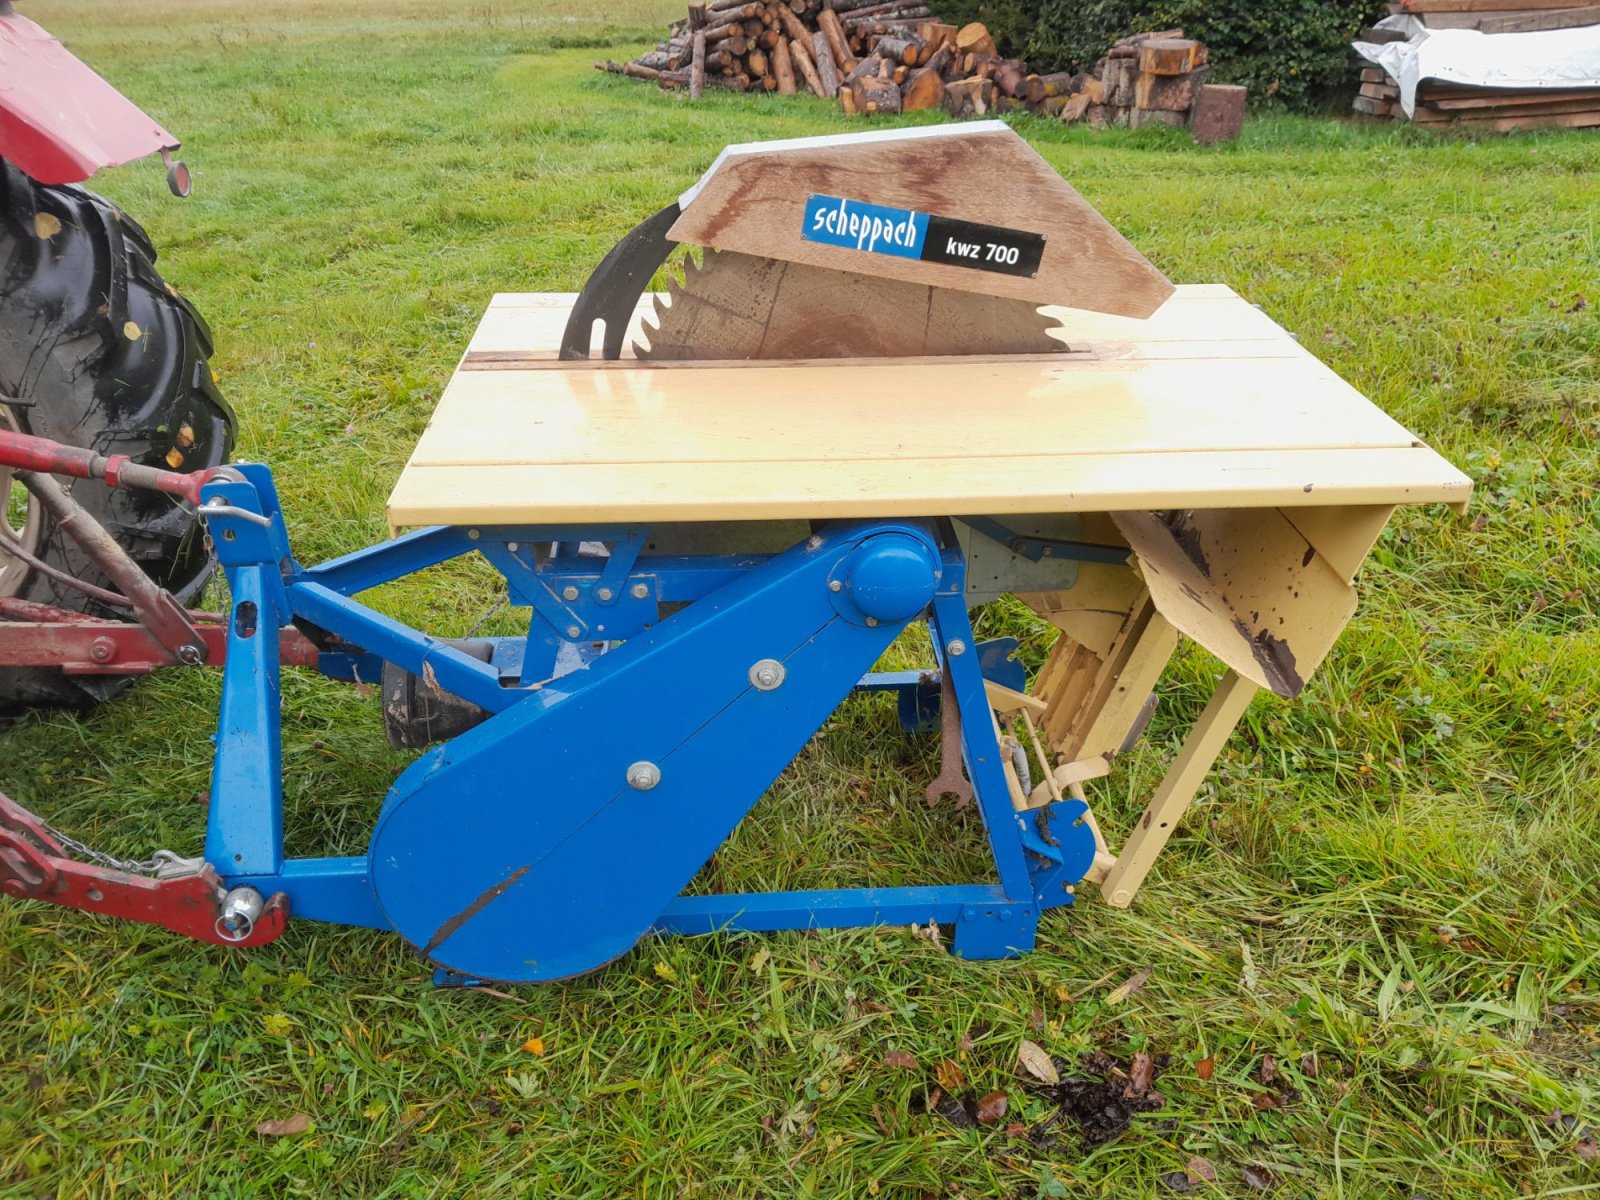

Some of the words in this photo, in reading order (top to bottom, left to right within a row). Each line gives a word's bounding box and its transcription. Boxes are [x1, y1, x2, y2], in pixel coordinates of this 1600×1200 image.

[813, 198, 917, 252] scheppach
[946, 237, 980, 259] kwz
[986, 243, 1020, 265] 700
